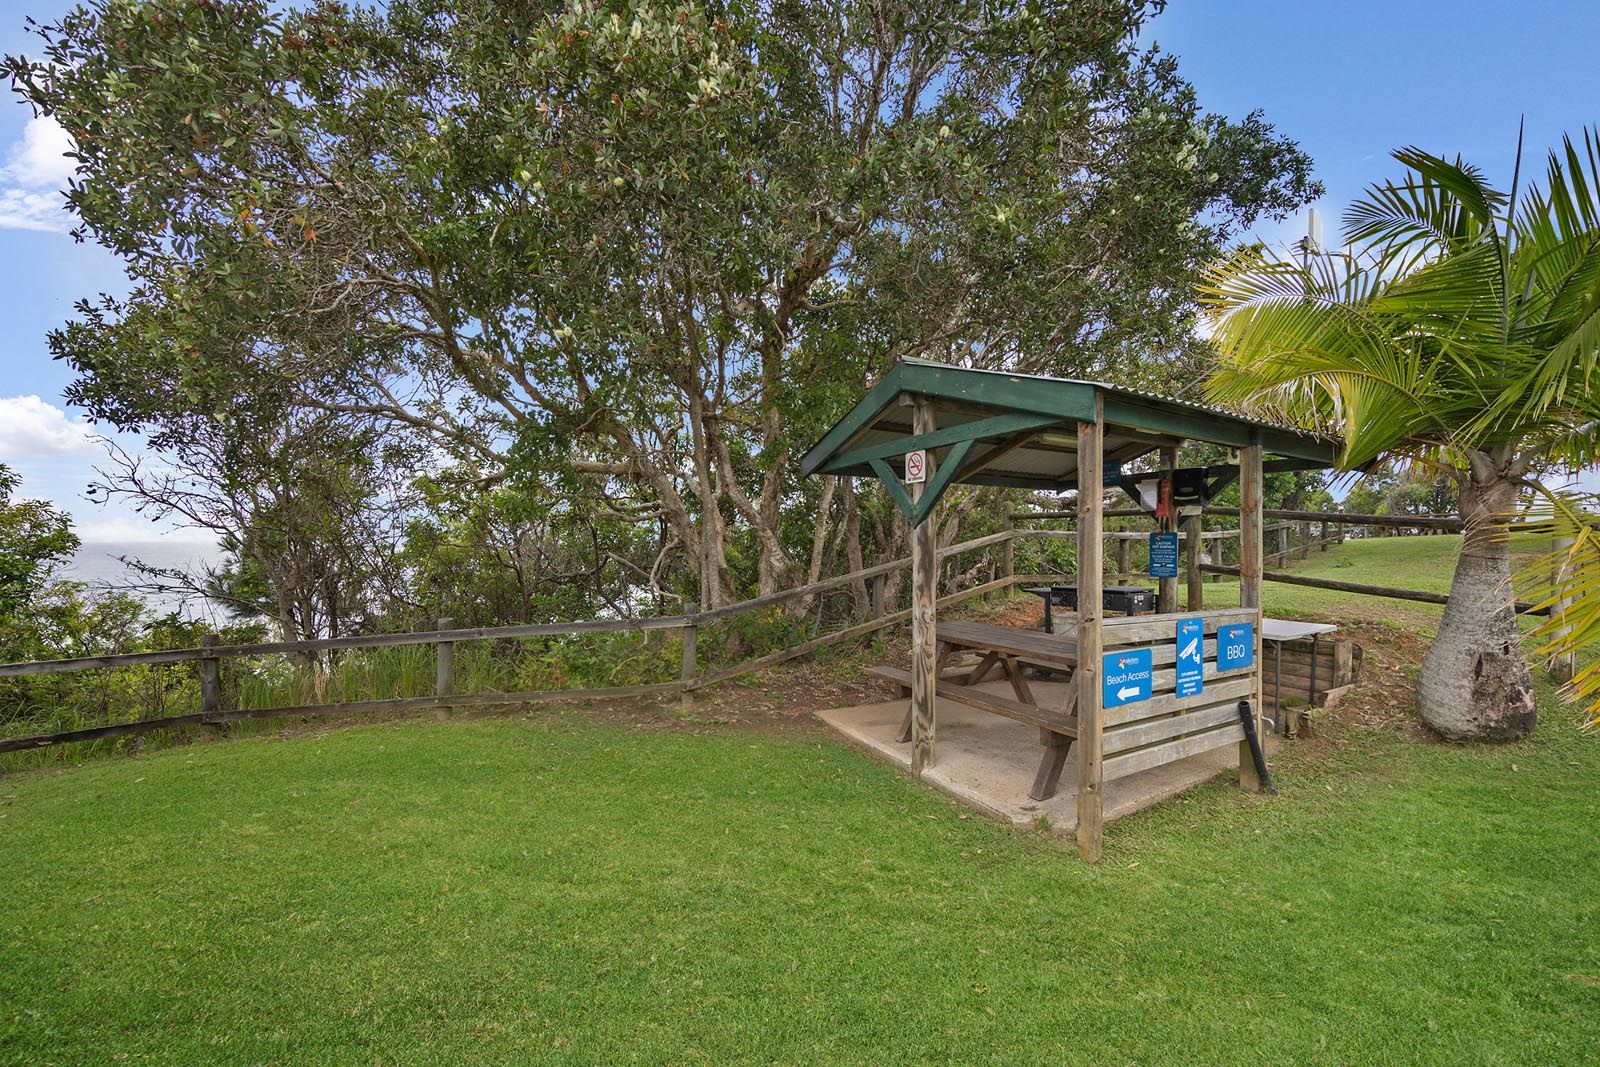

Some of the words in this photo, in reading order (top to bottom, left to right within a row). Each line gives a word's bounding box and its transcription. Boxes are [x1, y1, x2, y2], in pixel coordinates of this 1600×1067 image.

[1227, 644, 1246, 660] BBQ
[1106, 673, 1127, 686] Beach
[1128, 670, 1150, 681] Access
